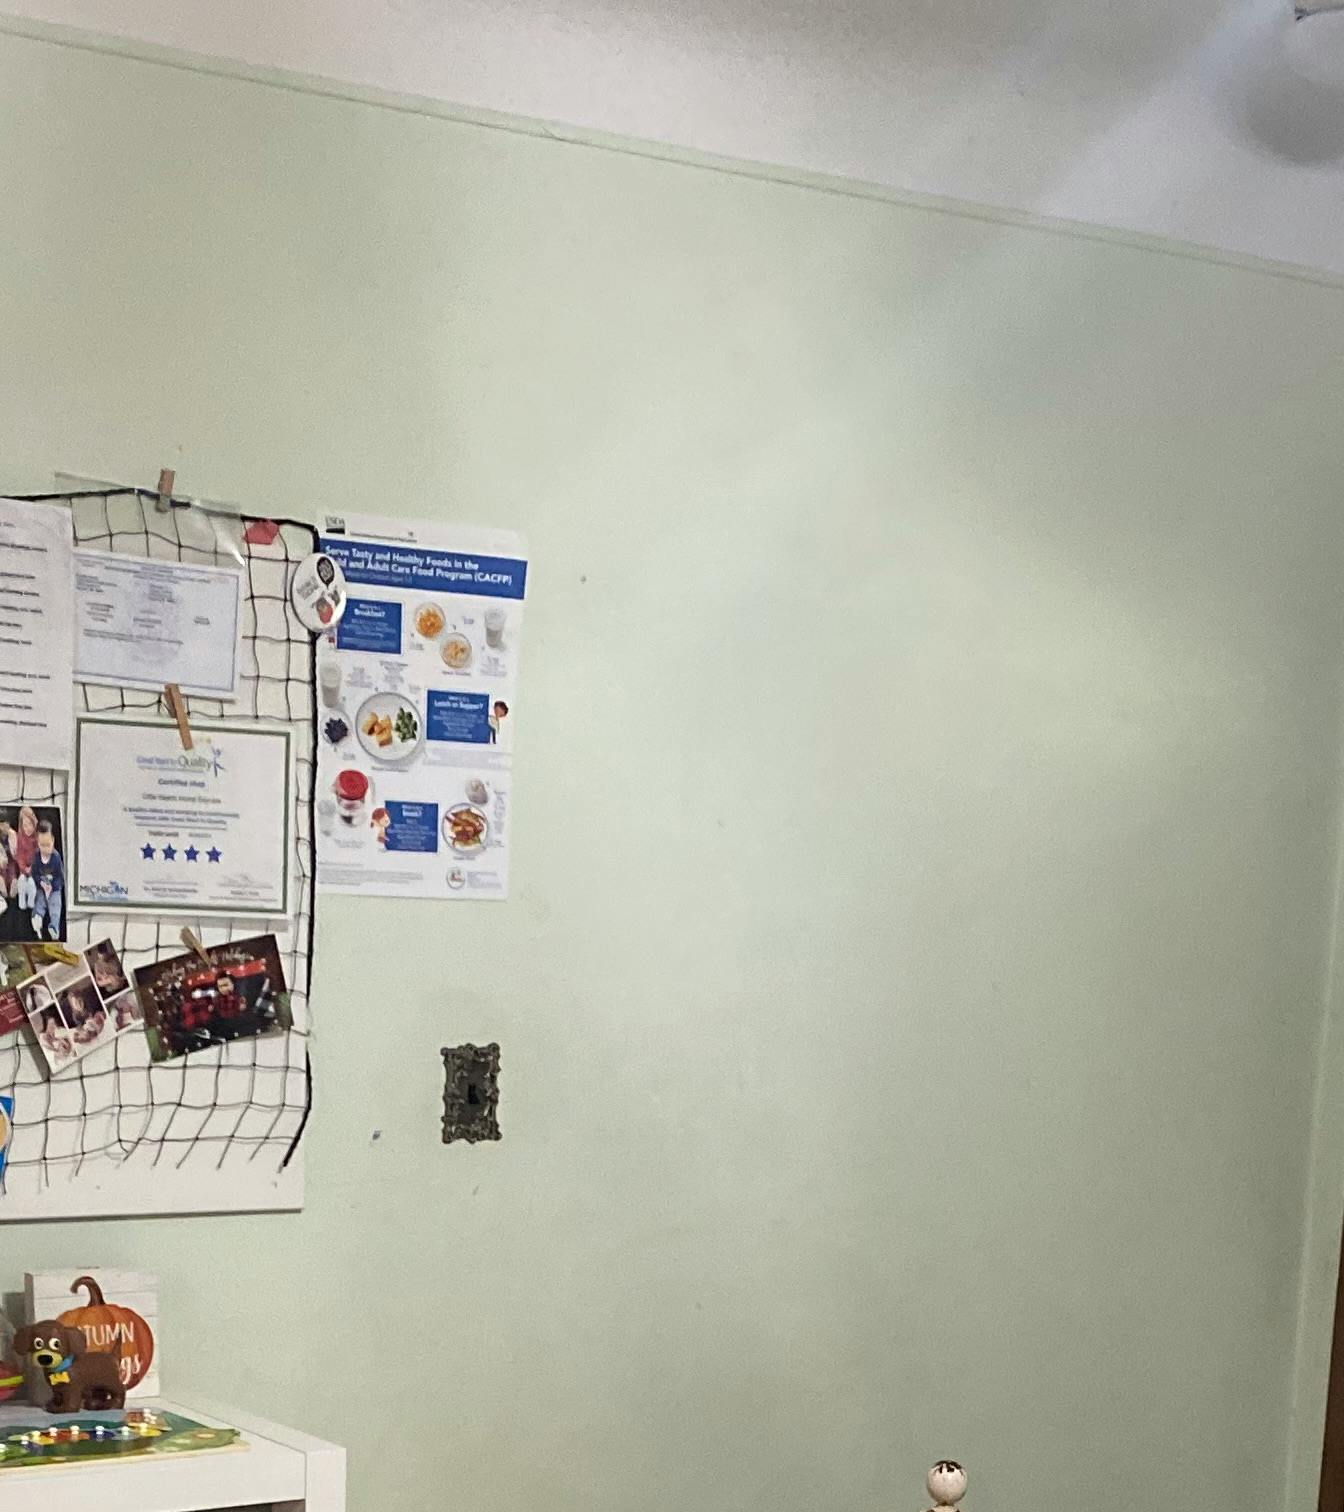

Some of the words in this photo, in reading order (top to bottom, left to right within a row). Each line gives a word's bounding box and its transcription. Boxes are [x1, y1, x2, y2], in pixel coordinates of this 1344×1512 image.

[325, 545, 350, 558] Serve
[352, 546, 373, 562] Tasty
[375, 551, 391, 561] and
[392, 552, 428, 569] Healthy
[426, 556, 453, 569] Foods
[454, 559, 463, 569] in
[464, 560, 480, 571] the
[349, 559, 365, 570] and
[367, 560, 390, 573] Adult
[392, 562, 411, 574] Care
[412, 565, 435, 577] Food
[436, 567, 473, 582] Program
[474, 571, 514, 587] (CACFP)
[78, 1320, 134, 1347] TUMN
